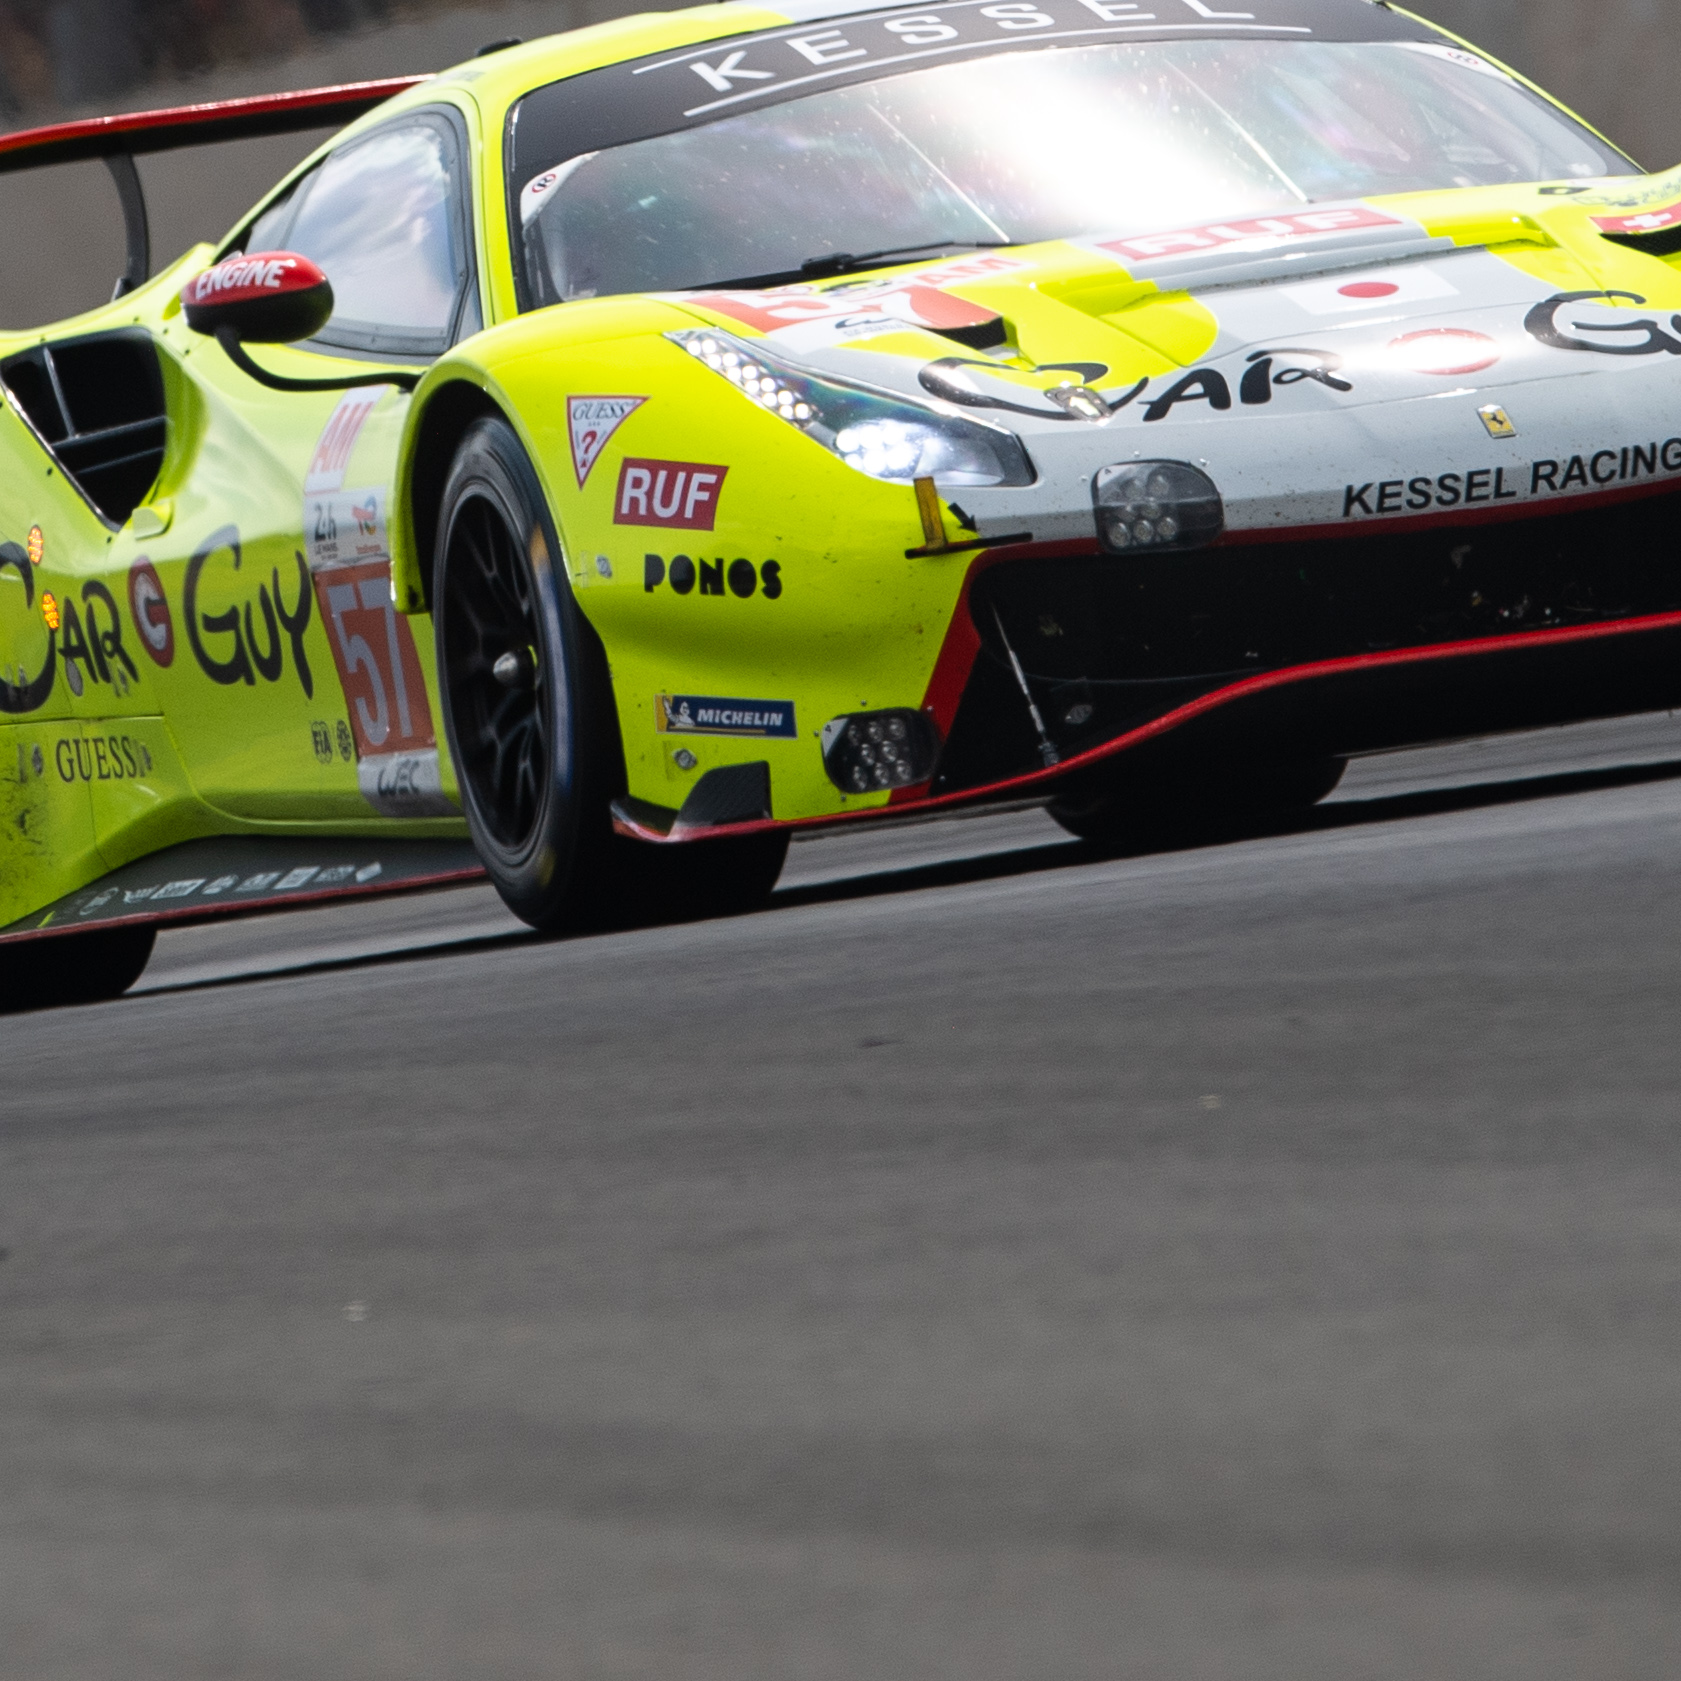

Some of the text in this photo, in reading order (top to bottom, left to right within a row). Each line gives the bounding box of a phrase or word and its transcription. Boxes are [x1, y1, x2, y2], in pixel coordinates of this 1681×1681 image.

[195, 259, 290, 301] ENGINE
[571, 400, 628, 421] GUESS
[621, 466, 718, 519] RUF
[1342, 466, 1517, 518] KESSEL
[644, 553, 783, 601] PONOS
[182, 522, 314, 700] GUY
[325, 576, 415, 747] 57
[696, 708, 784, 727] MICHELIN
[55, 735, 137, 784] GUESS
